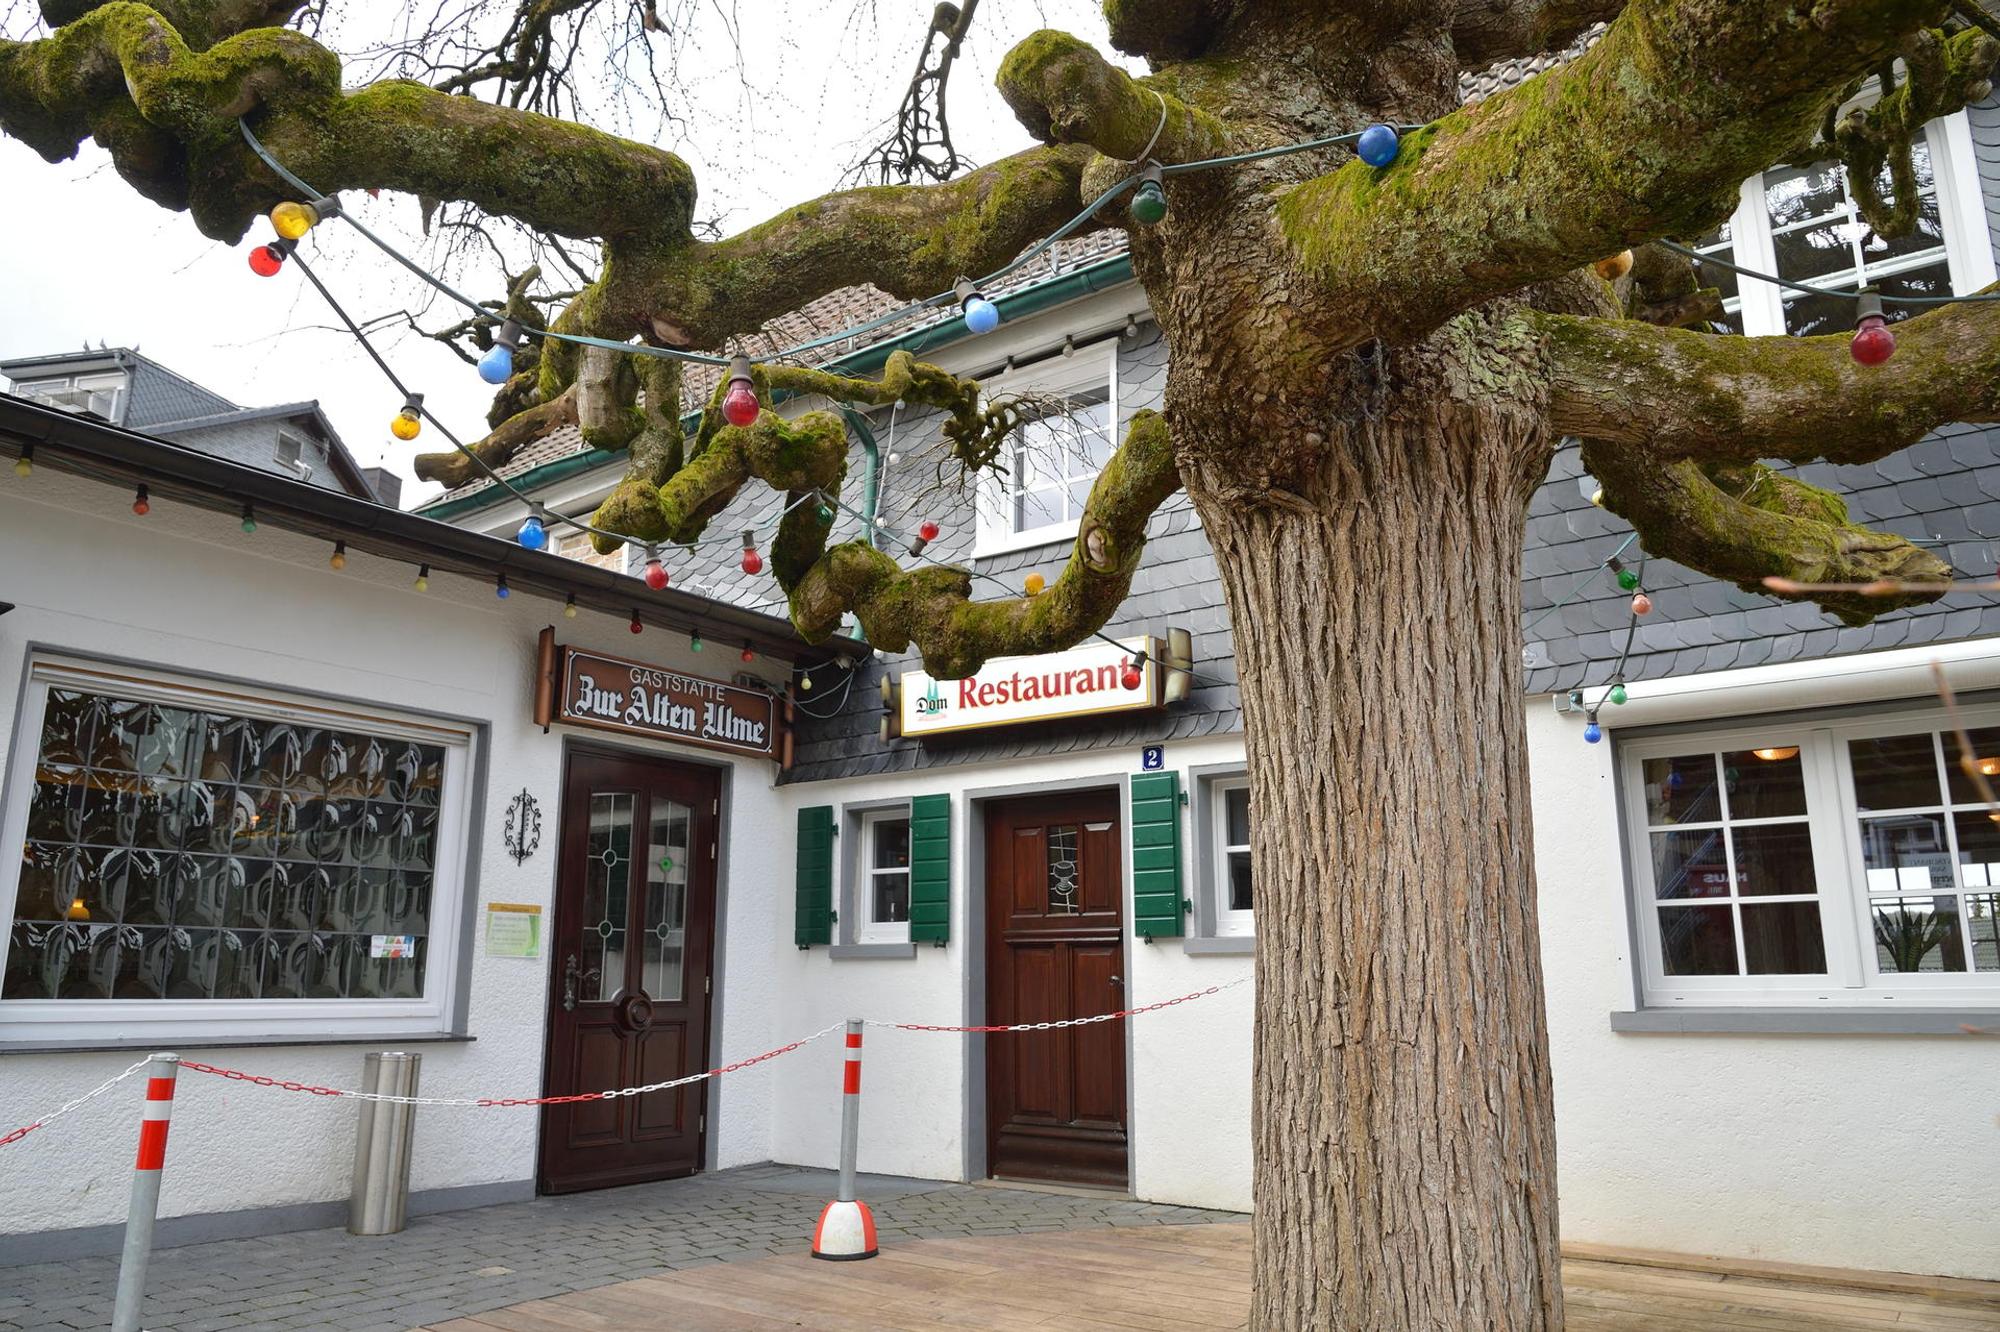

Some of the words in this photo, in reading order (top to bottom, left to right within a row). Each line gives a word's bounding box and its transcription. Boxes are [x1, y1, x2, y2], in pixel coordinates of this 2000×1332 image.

[575, 674, 624, 719] Zur
[624, 685, 697, 732] Alten
[701, 701, 766, 745] Ulme
[916, 697, 948, 713] Dom
[1148, 750, 1158, 767] 2
